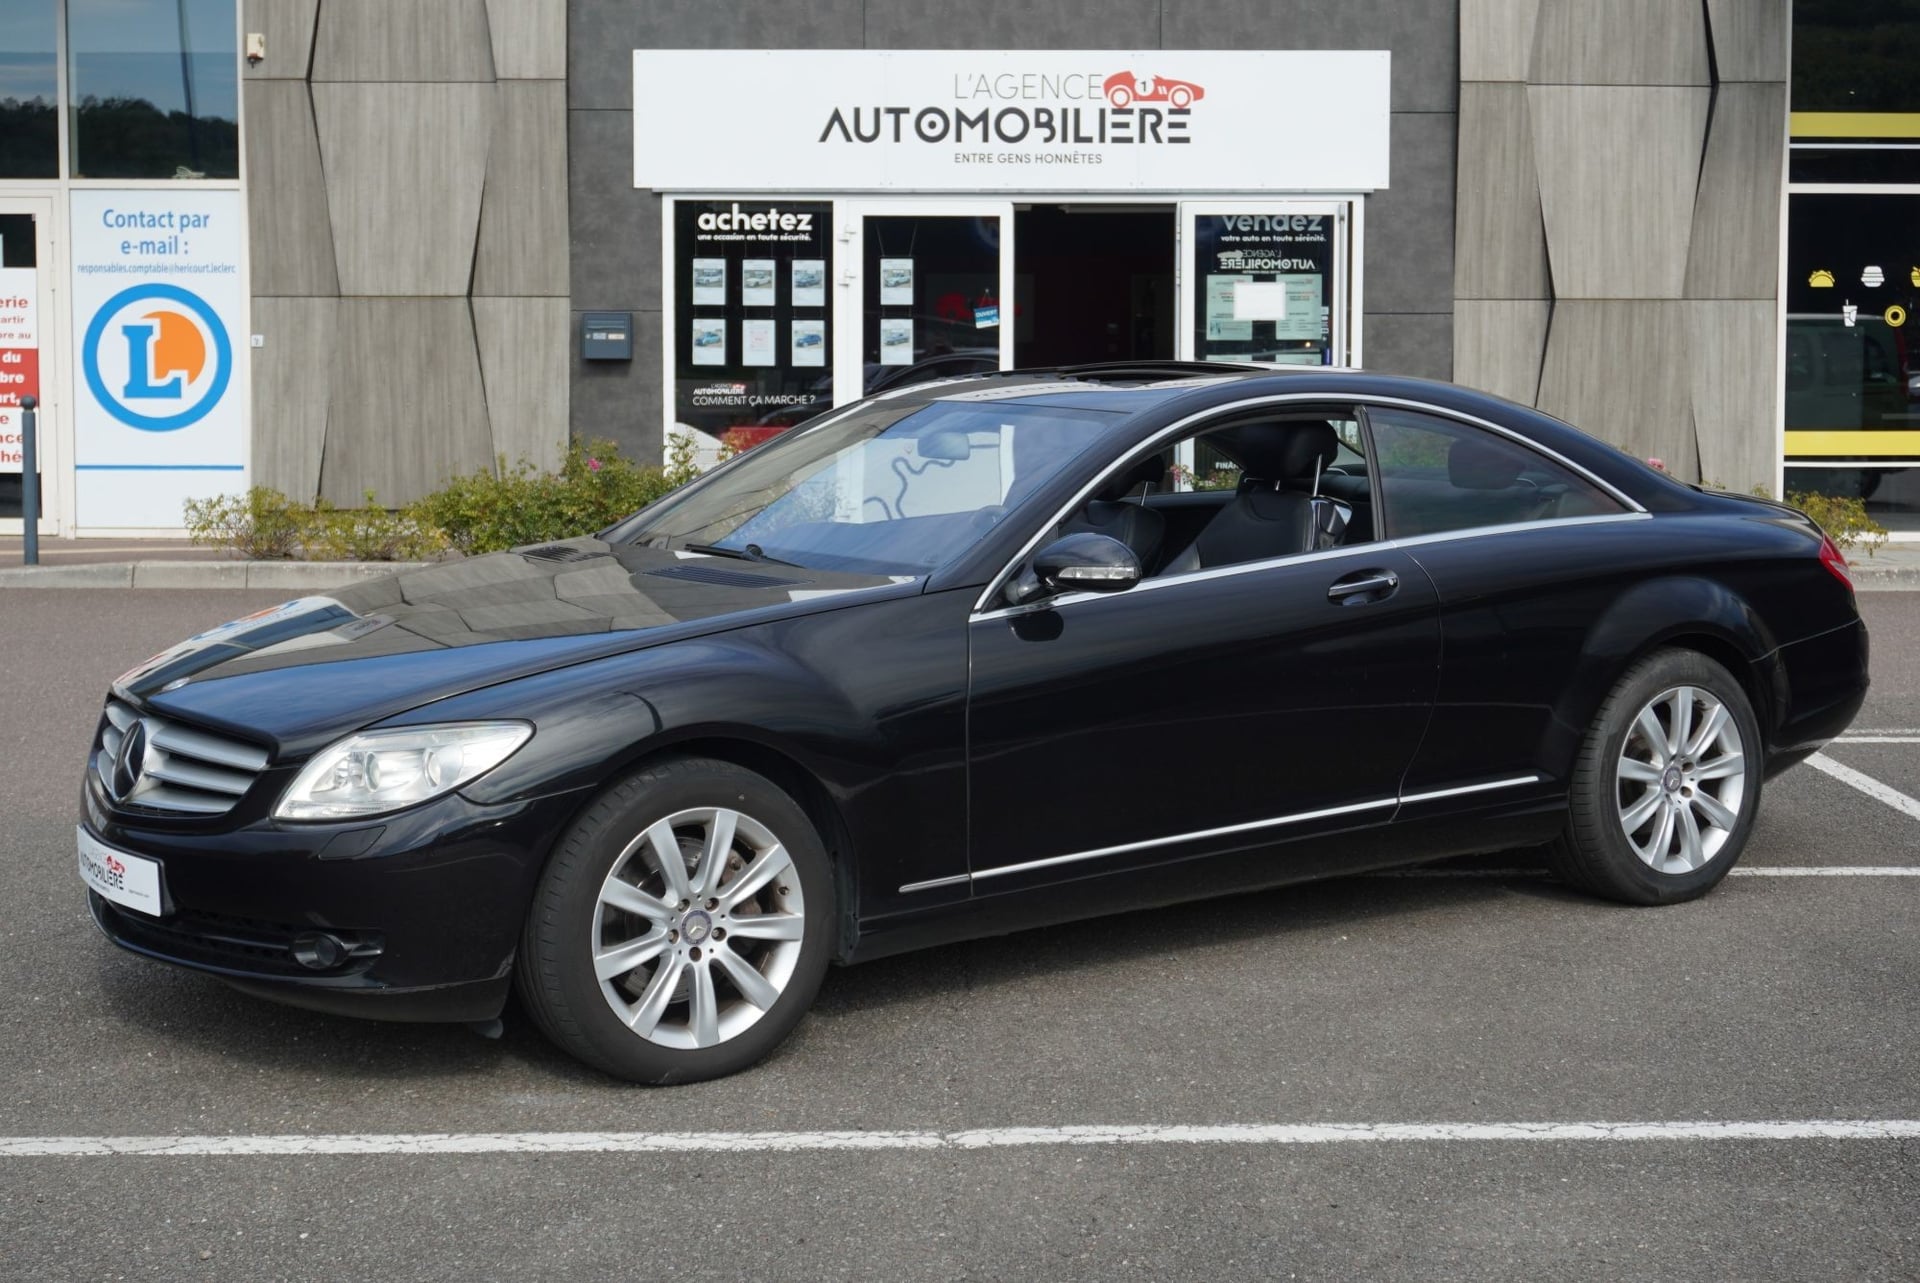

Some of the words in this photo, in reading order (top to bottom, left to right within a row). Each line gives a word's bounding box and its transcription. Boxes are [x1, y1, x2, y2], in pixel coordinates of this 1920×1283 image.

[954, 73, 1104, 100] L'AGENCE
[1140, 80, 1147, 92] 1
[954, 153, 994, 164] ENTRE
[997, 153, 1031, 164] GENS
[1035, 150, 1103, 164] HONNÊTES
[102, 208, 174, 228] Contact
[179, 213, 210, 233] par
[697, 202, 813, 231] achetez
[713, 233, 745, 241] occasion
[758, 233, 778, 241] toute
[121, 235, 178, 255] e-mail
[2, 351, 21, 363] du
[692, 395, 747, 405] COMMENT
[748, 395, 762, 407] ÇA
[764, 395, 808, 405] MARCHE
[810, 395, 816, 404] ?
